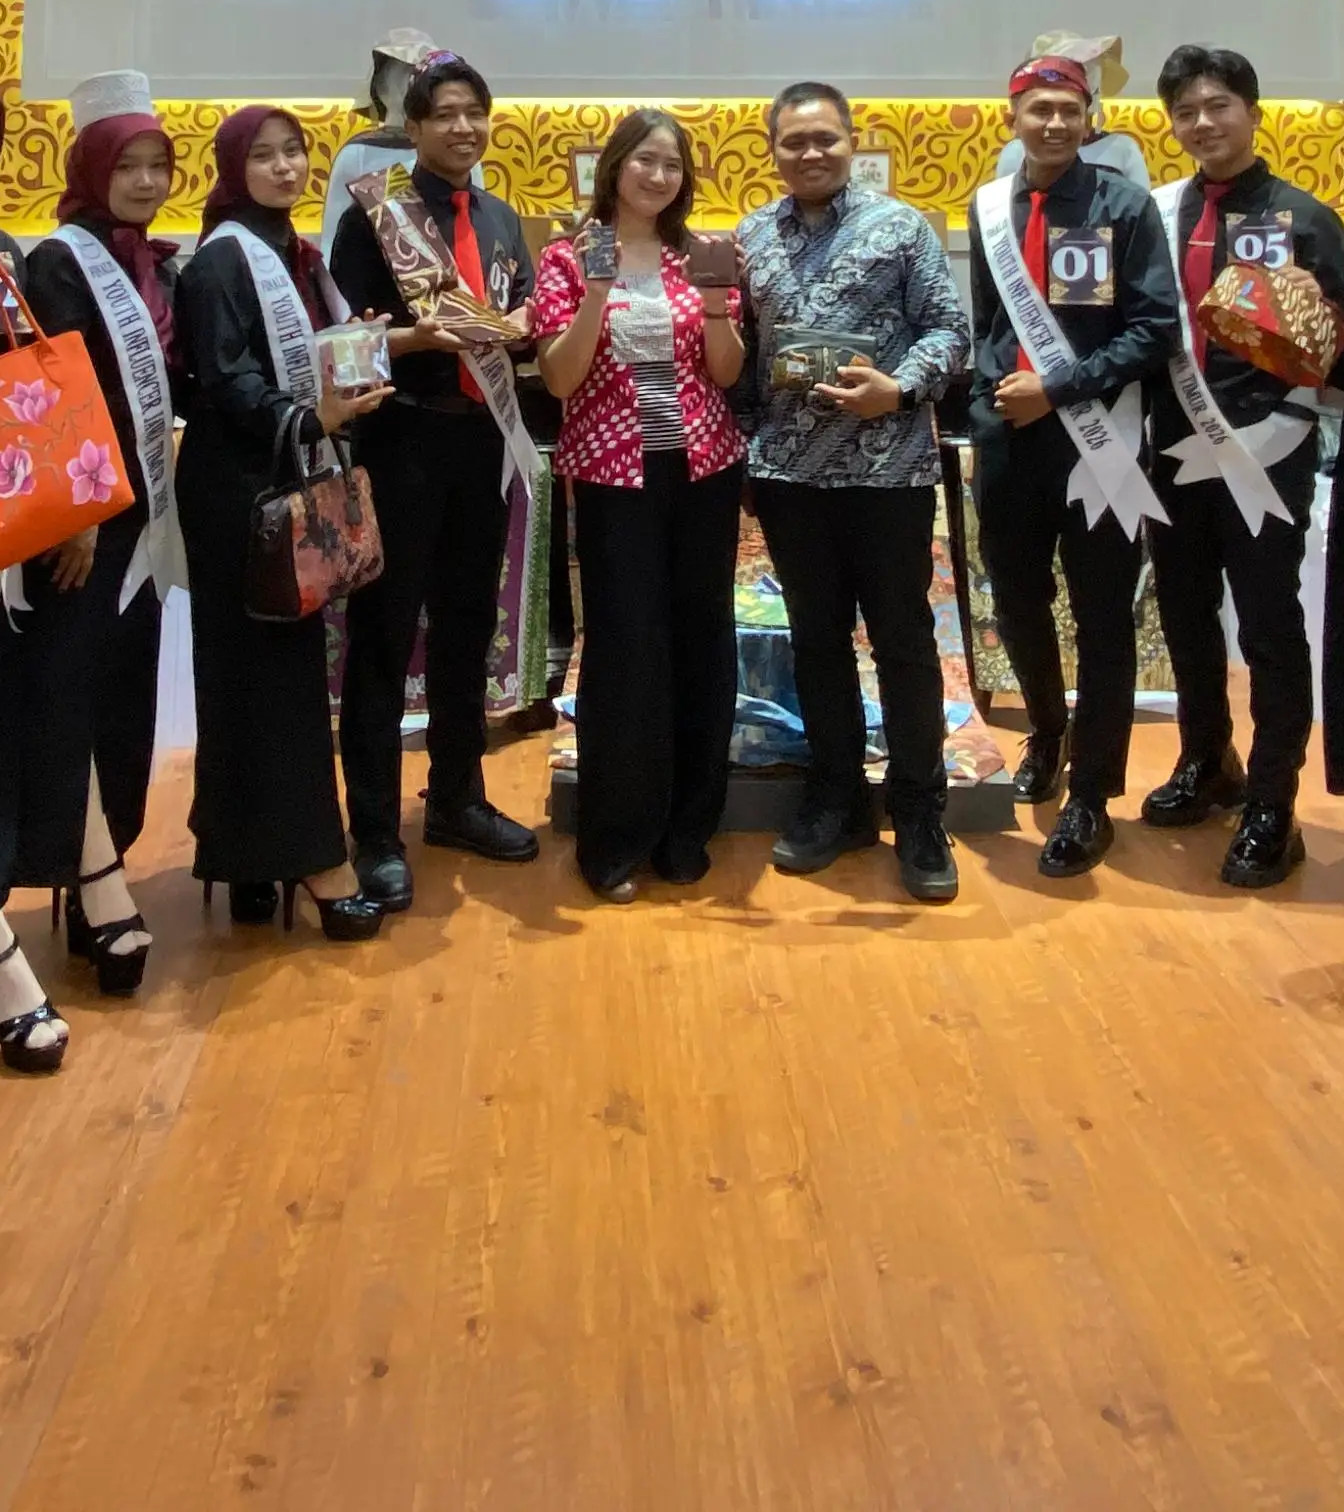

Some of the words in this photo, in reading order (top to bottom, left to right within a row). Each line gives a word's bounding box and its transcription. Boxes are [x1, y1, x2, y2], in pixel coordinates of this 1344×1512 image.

[1051, 246, 1108, 282] 01
[1234, 231, 1289, 269] 05
[489, 262, 510, 310] 03
[271, 294, 304, 344] YOUTH
[1006, 276, 1055, 352] INFLUENCER
[103, 278, 141, 329] YOUTH
[122, 327, 165, 415] INFLUENCER
[1182, 370, 1208, 415] TIMUR
[1199, 417, 1230, 446] 2026
[1077, 419, 1113, 451] 2026
